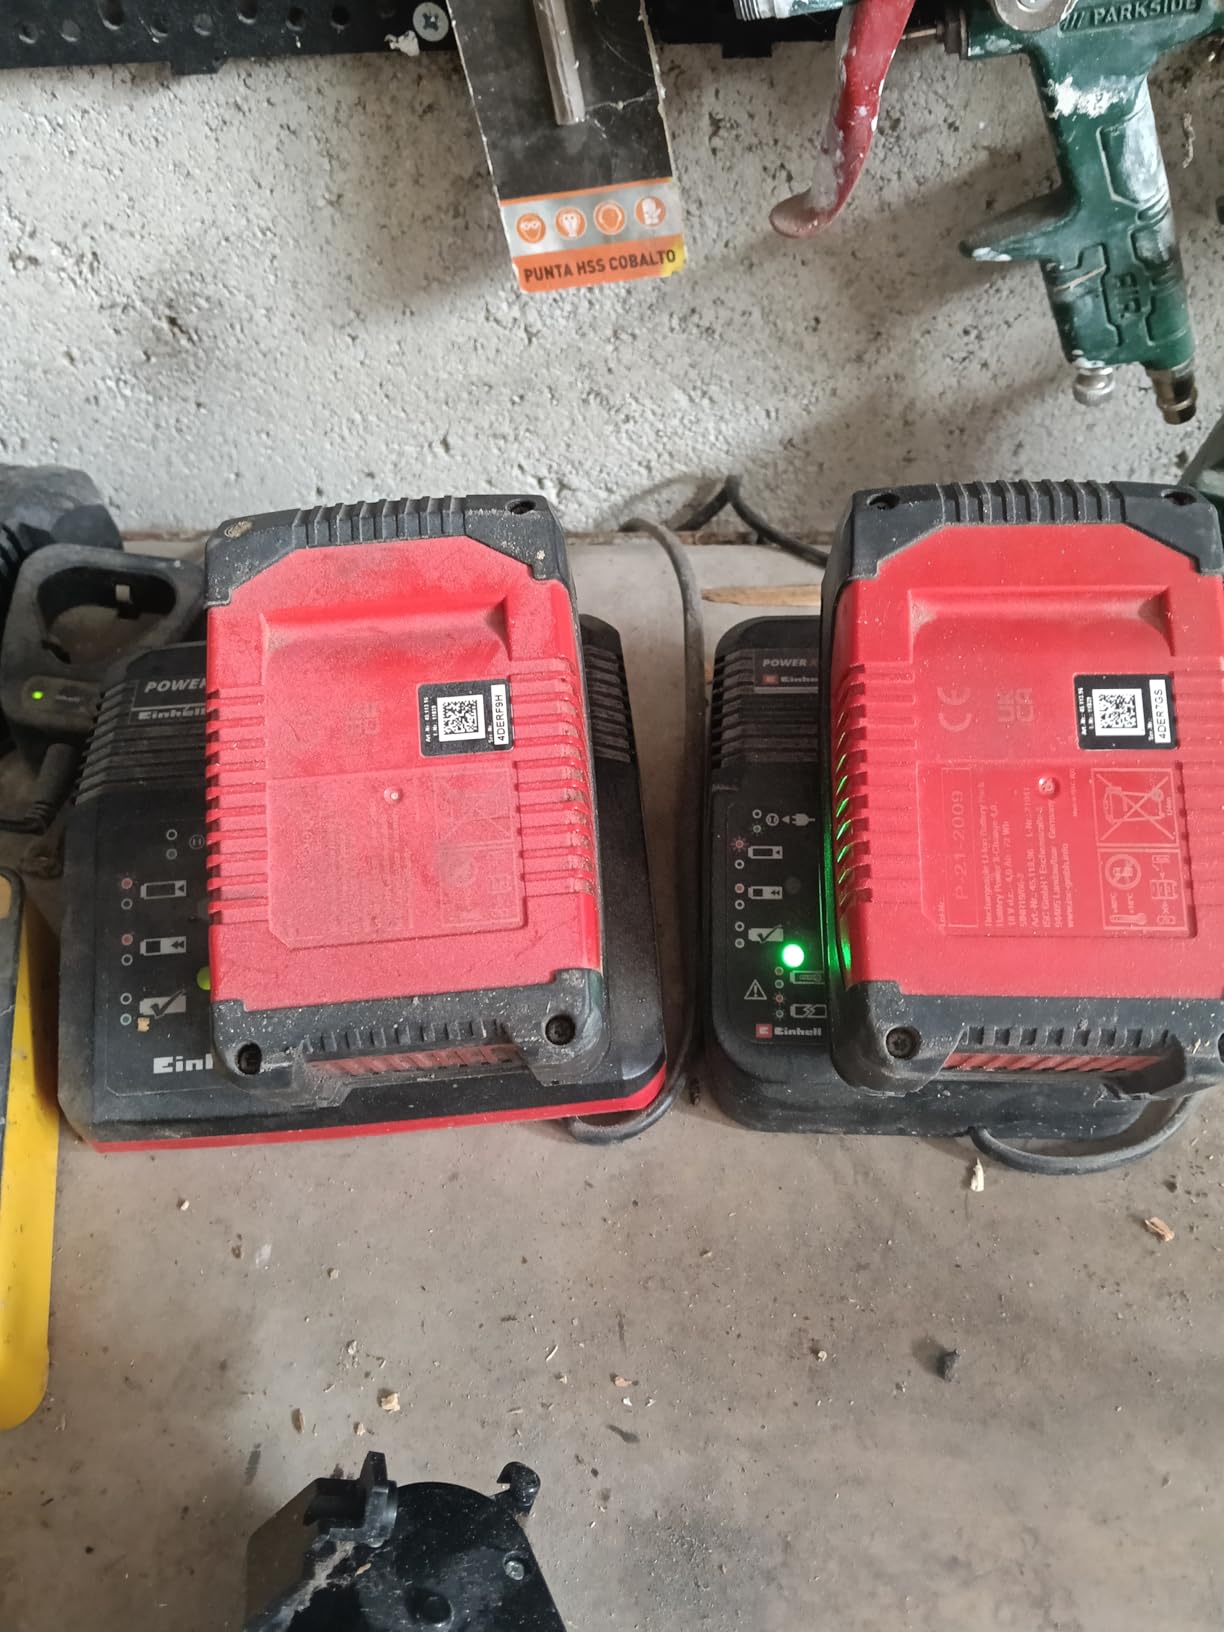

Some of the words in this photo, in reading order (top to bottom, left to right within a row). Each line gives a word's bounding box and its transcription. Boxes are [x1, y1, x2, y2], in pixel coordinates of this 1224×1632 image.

[1093, 0, 1196, 25] PARKSIDE
[523, 263, 574, 283] PUNTA
[576, 258, 606, 277] HSS
[608, 249, 677, 271] COBALTO
[762, 658, 807, 668] POWER
[494, 694, 506, 742] 4DERF9H
[1154, 688, 1166, 740] 4DER7GS
[774, 1027, 821, 1036] Einhell
